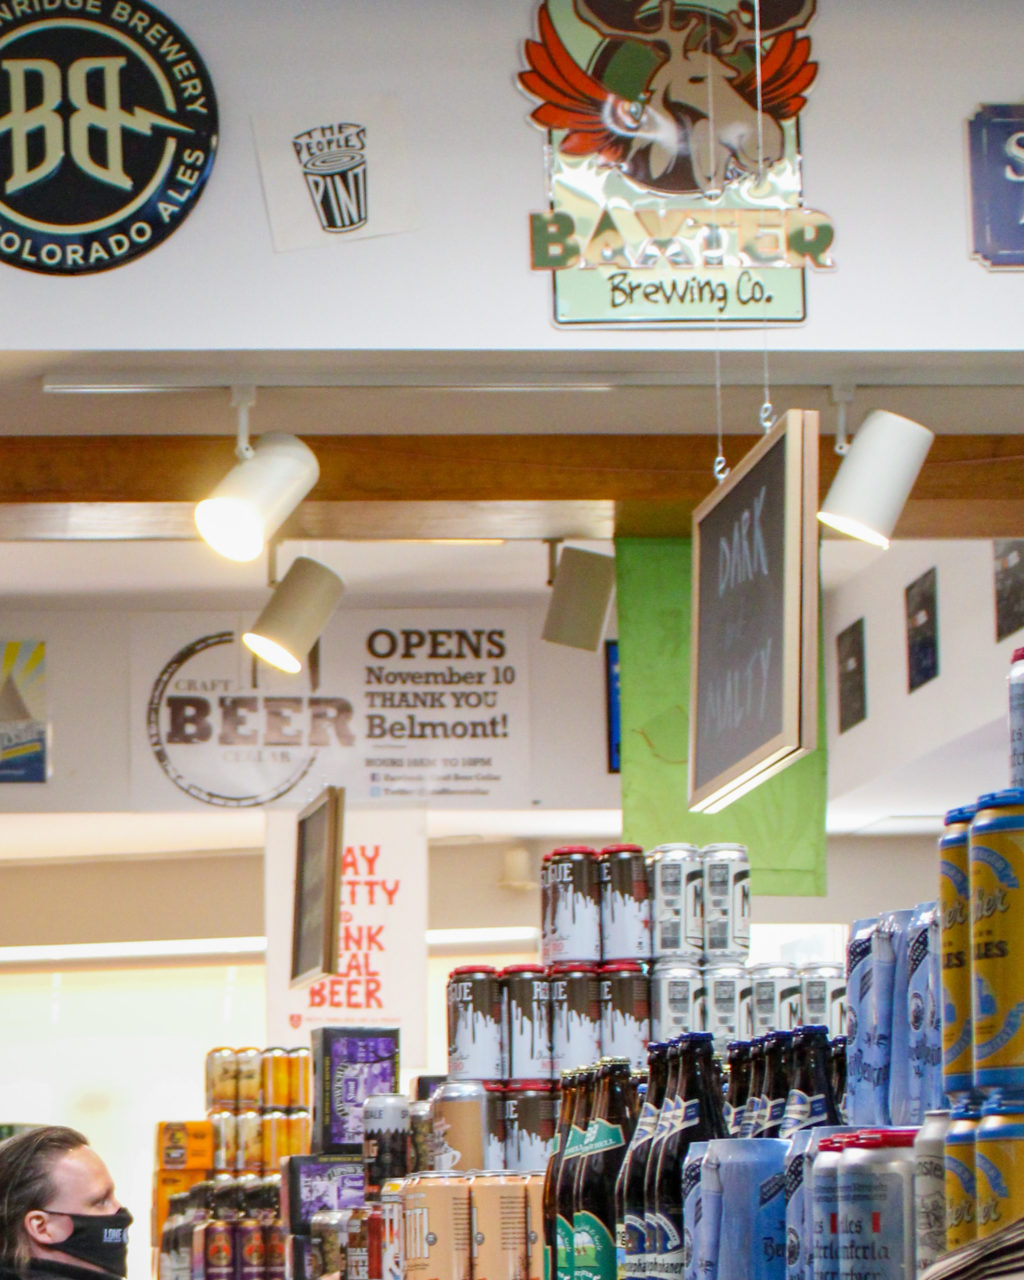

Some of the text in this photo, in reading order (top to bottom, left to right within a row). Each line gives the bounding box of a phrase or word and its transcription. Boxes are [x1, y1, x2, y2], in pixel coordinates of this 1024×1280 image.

[111, 1, 208, 117] BREWERY
[293, 122, 366, 140] THE
[156, 148, 205, 223] ALES
[305, 165, 367, 229] PINT
[529, 208, 835, 270] BAXTER
[607, 271, 774, 313] Brewing Co.
[717, 486, 769, 598] DARK
[366, 629, 507, 659] OPENS
[174, 679, 232, 692] CRAFT
[365, 665, 516, 685] November 10
[365, 691, 498, 708] THANK YOU
[166, 695, 356, 747] BEER
[365, 713, 510, 739] Belmont!
[308, 977, 384, 1009] BEER
